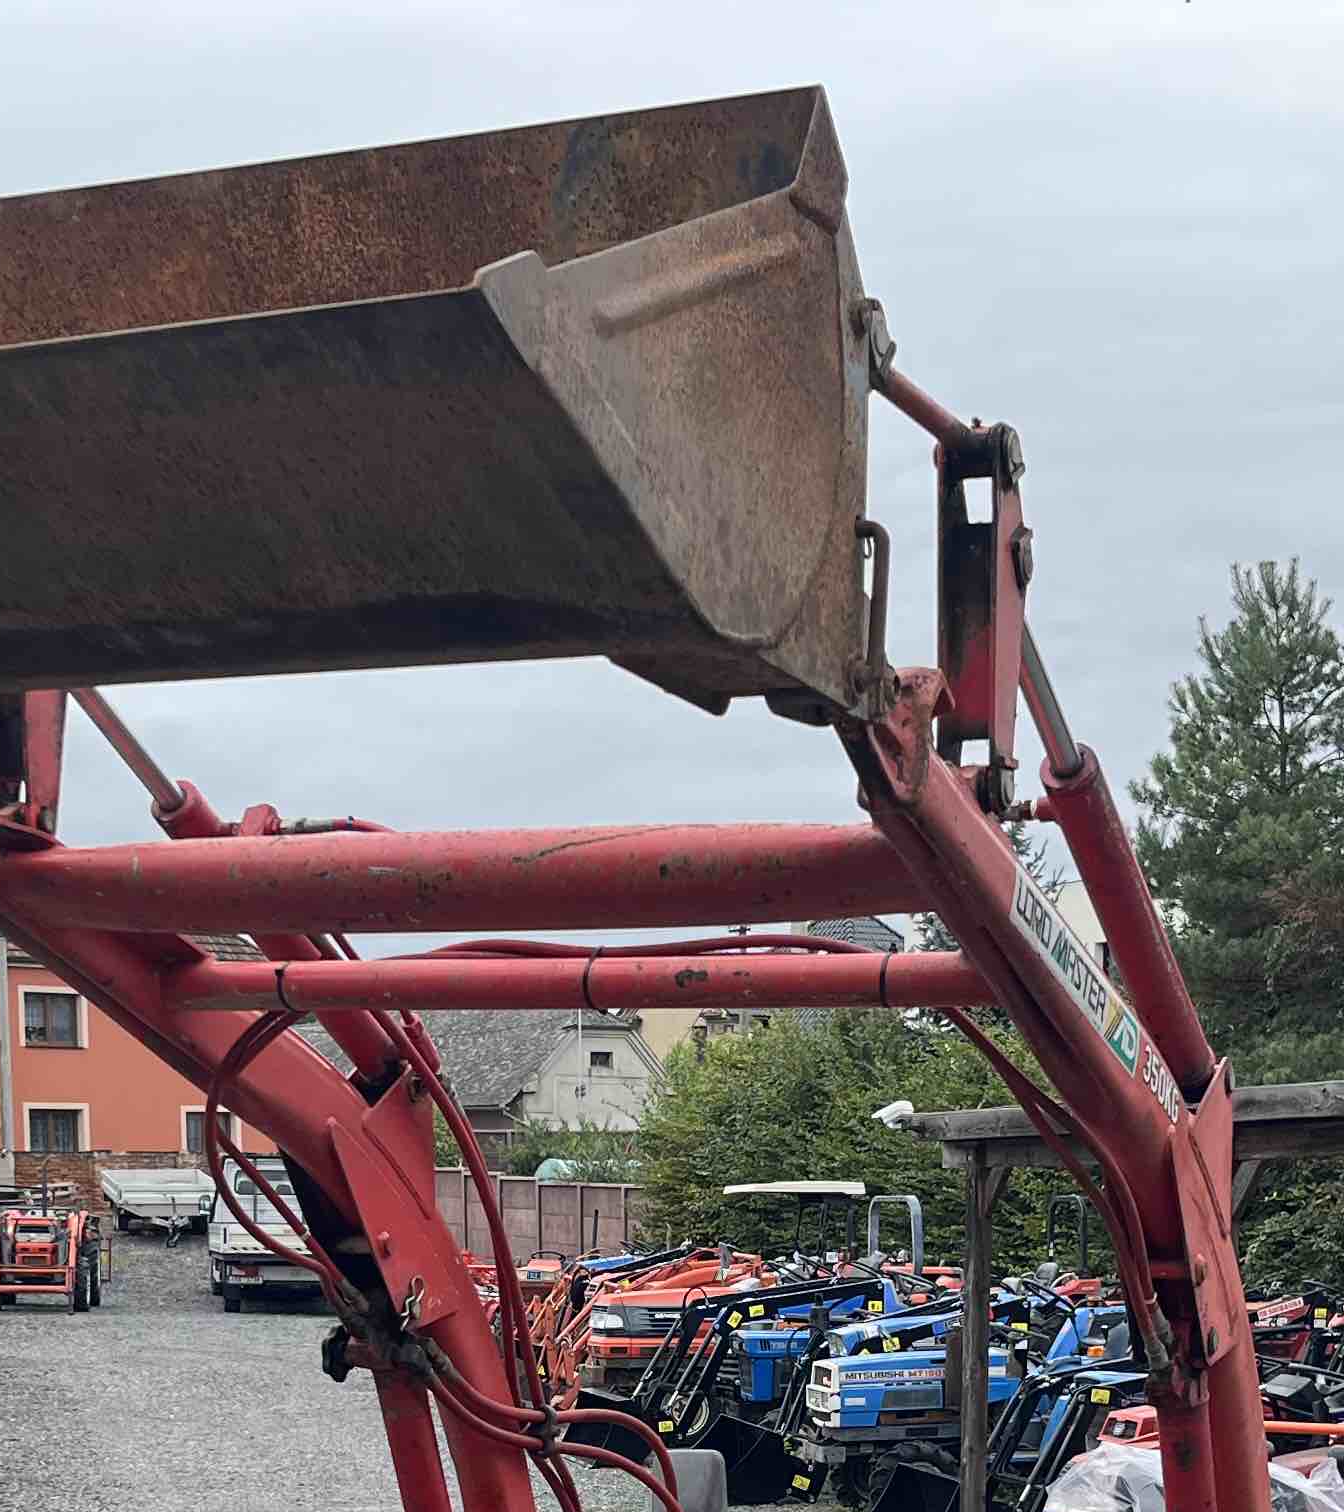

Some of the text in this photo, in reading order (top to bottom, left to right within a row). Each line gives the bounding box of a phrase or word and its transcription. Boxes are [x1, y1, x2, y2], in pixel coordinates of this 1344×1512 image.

[1051, 928, 1107, 1025] MASTER
[1143, 1045, 1180, 1123] 350KG
[845, 1370, 905, 1381] MITSUBISHI
